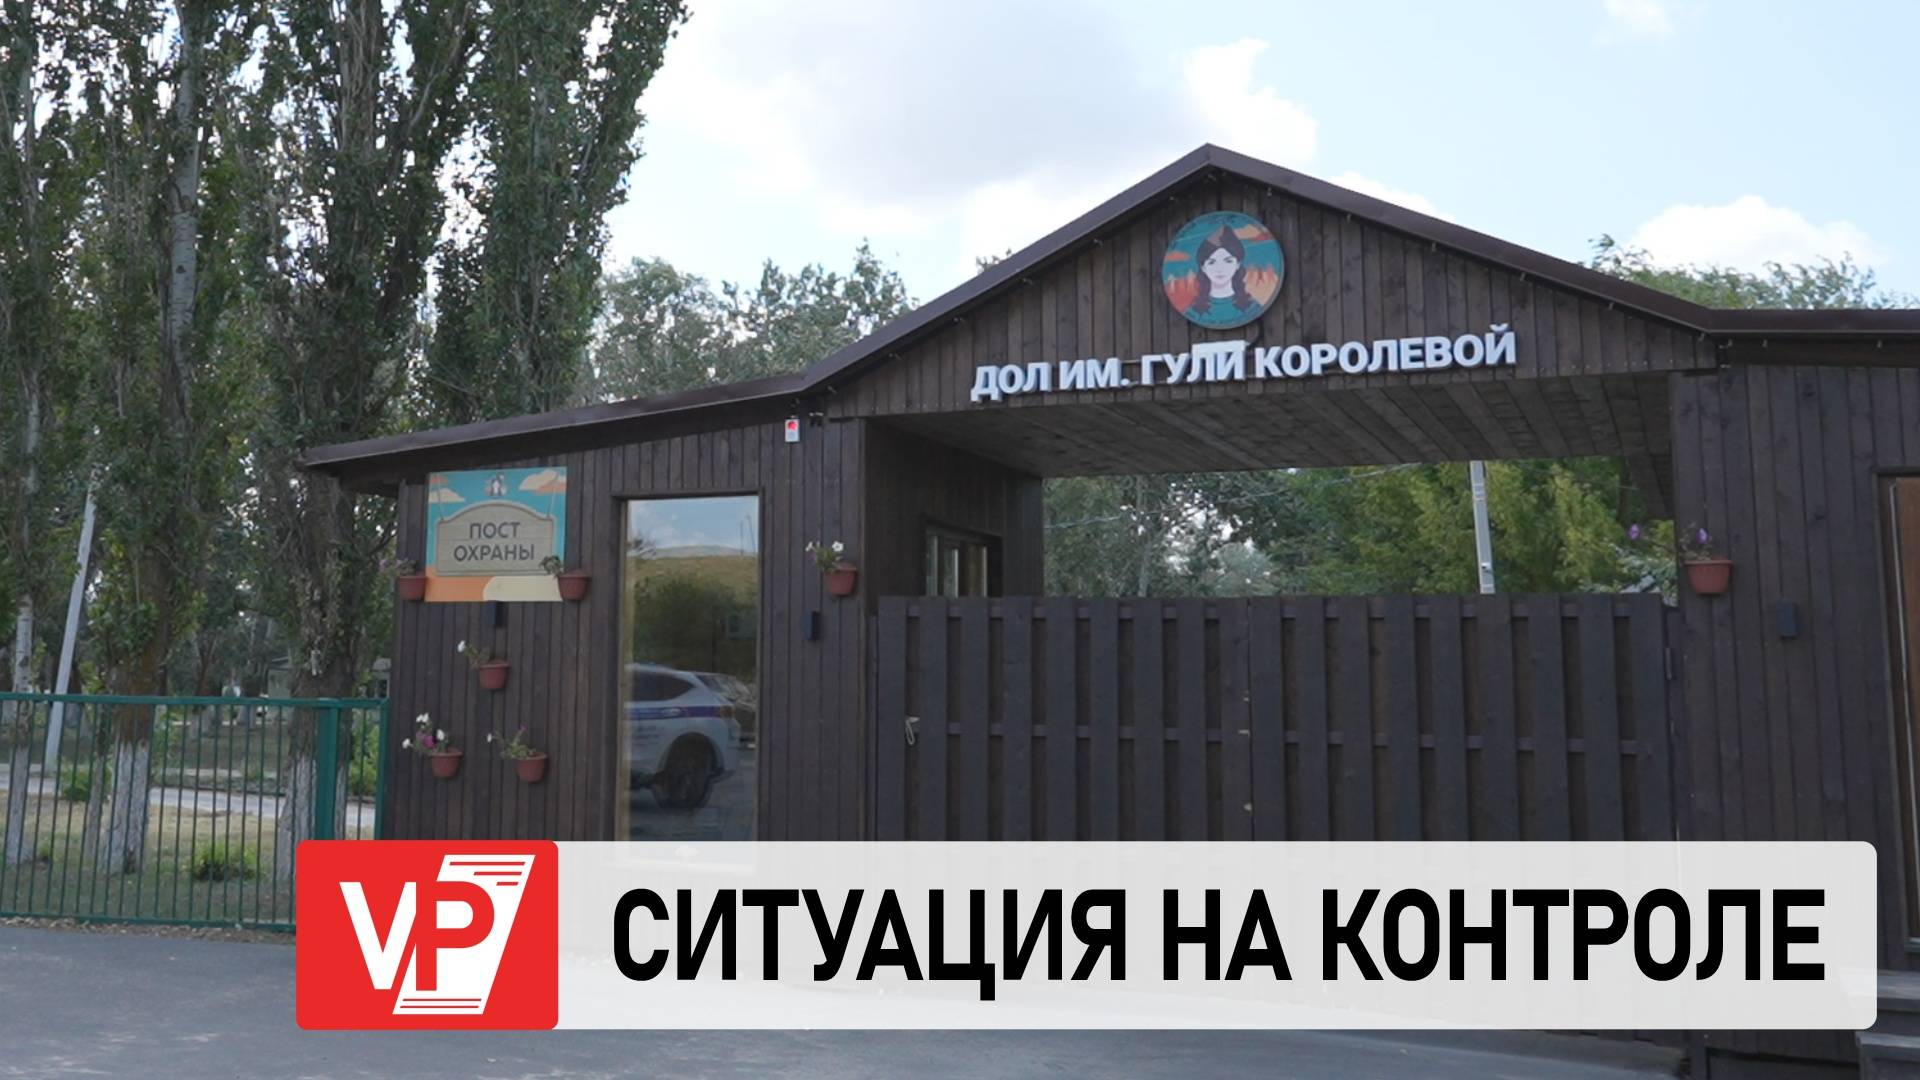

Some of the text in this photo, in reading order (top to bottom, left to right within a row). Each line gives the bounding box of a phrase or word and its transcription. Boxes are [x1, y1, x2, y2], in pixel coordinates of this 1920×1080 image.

[970, 323, 1517, 402] ДОЛ ИМ. ГУЛИ КОРОЛЕВОЙ
[469, 521, 521, 540] ПОСТ
[453, 543, 535, 562] ОХРАНЫ
